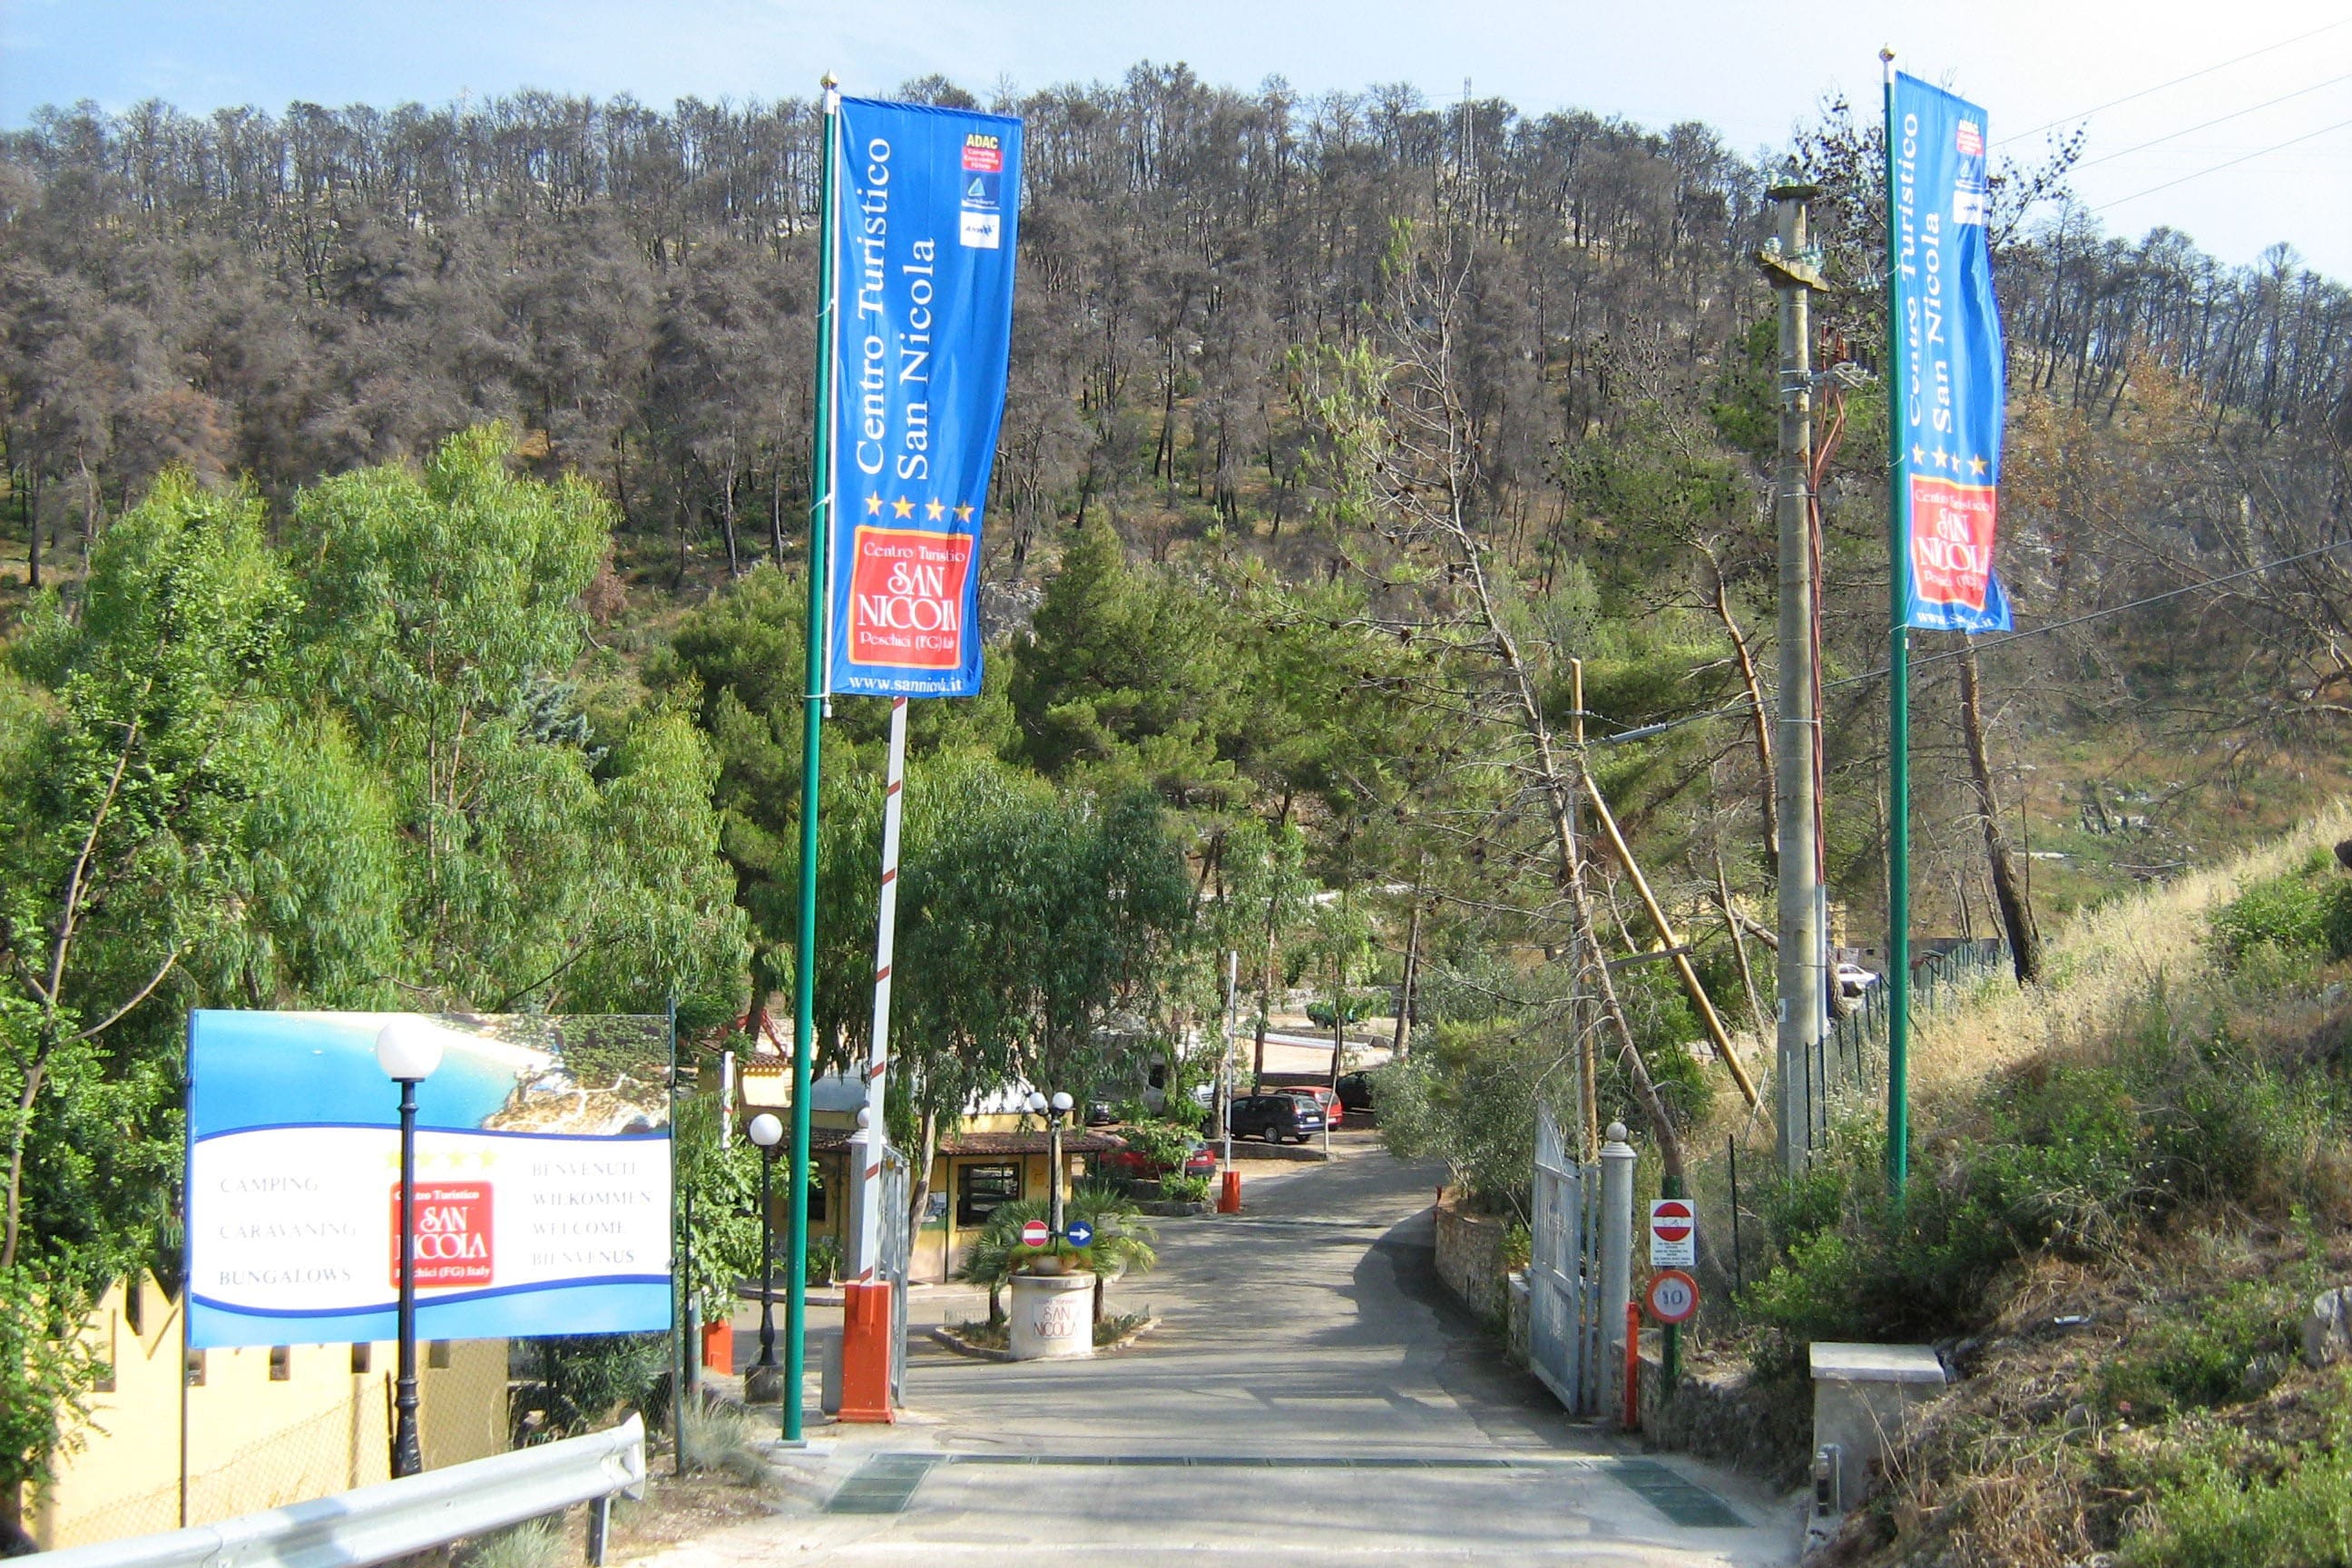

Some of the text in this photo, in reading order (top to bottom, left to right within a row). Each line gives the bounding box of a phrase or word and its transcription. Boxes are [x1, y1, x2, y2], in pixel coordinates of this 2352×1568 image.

[965, 133, 998, 149] ADAC
[1897, 113, 1918, 281] Turistico
[857, 137, 890, 475] Centro Turistico
[1921, 211, 1952, 434] San Nicola
[897, 237, 936, 480] San Nicola
[1936, 507, 1970, 543] SAN
[864, 542, 965, 562] Centro Turistio
[887, 561, 945, 598] SAN
[860, 631, 911, 648] Peschici
[220, 1177, 318, 1192] CAMPING
[395, 1189, 480, 1200] Ctro Turistico
[420, 1206, 468, 1233] SAN
[220, 1222, 356, 1239] CARAVANING
[219, 1269, 352, 1285] BUNGALOWS
[438, 1266, 465, 1278] (FG)
[466, 1265, 491, 1278] Italy
[1661, 1289, 1683, 1306] 10
[1044, 1307, 1071, 1321] SAN
[1033, 1321, 1079, 1337] NICOLA
